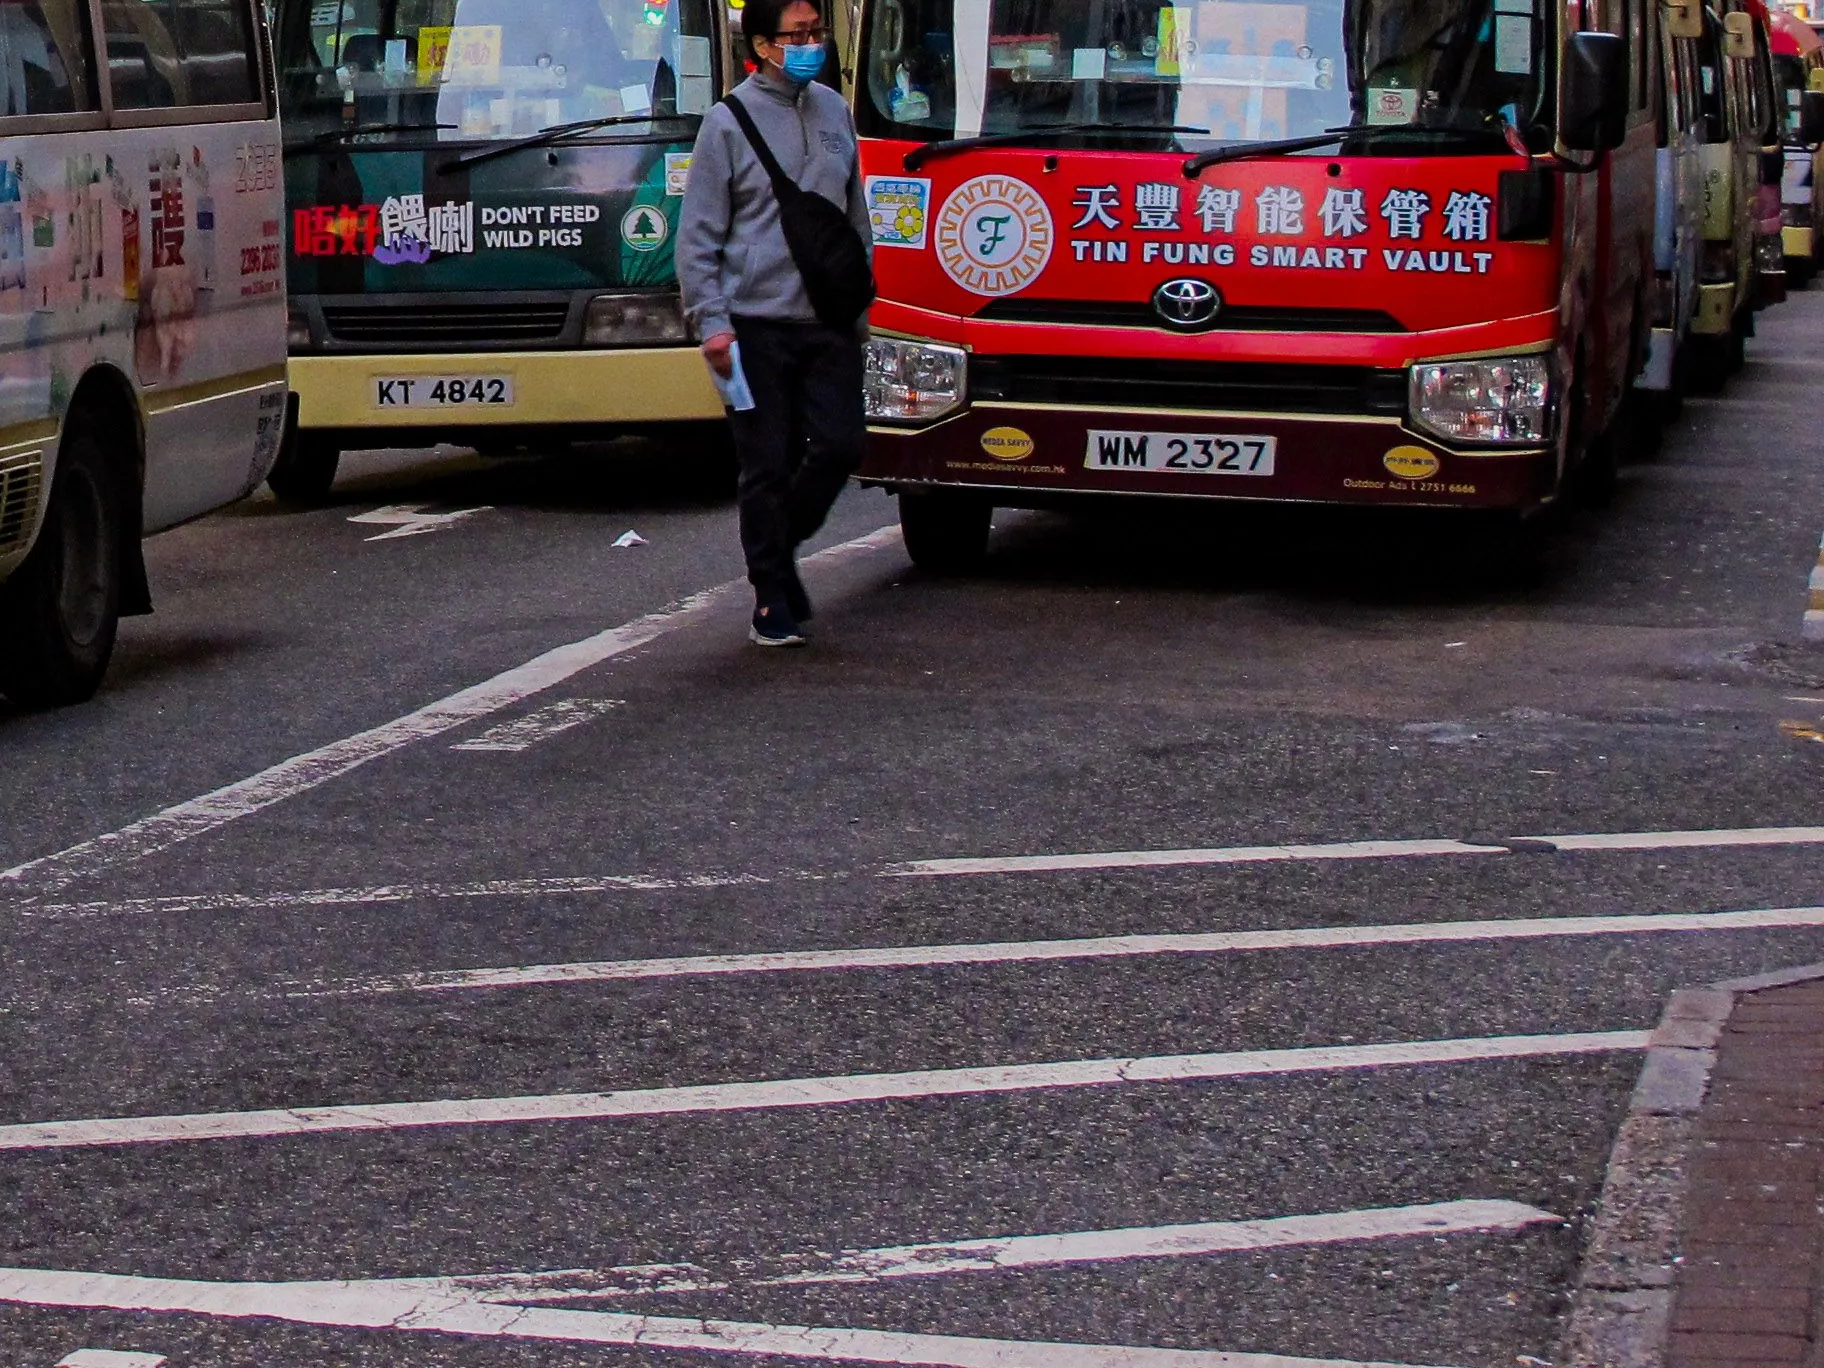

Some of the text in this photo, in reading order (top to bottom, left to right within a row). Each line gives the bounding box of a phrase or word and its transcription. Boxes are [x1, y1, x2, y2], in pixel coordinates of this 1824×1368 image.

[481, 205, 601, 225] DON'T FEED
[1072, 181, 1493, 242] 天豐智能保管箱
[484, 228, 582, 248] WILD PIGS
[1072, 240, 1493, 274] TIN FUNG SMART VAULT
[378, 379, 506, 405] KT 4842
[1097, 435, 1267, 472] WM 2327
